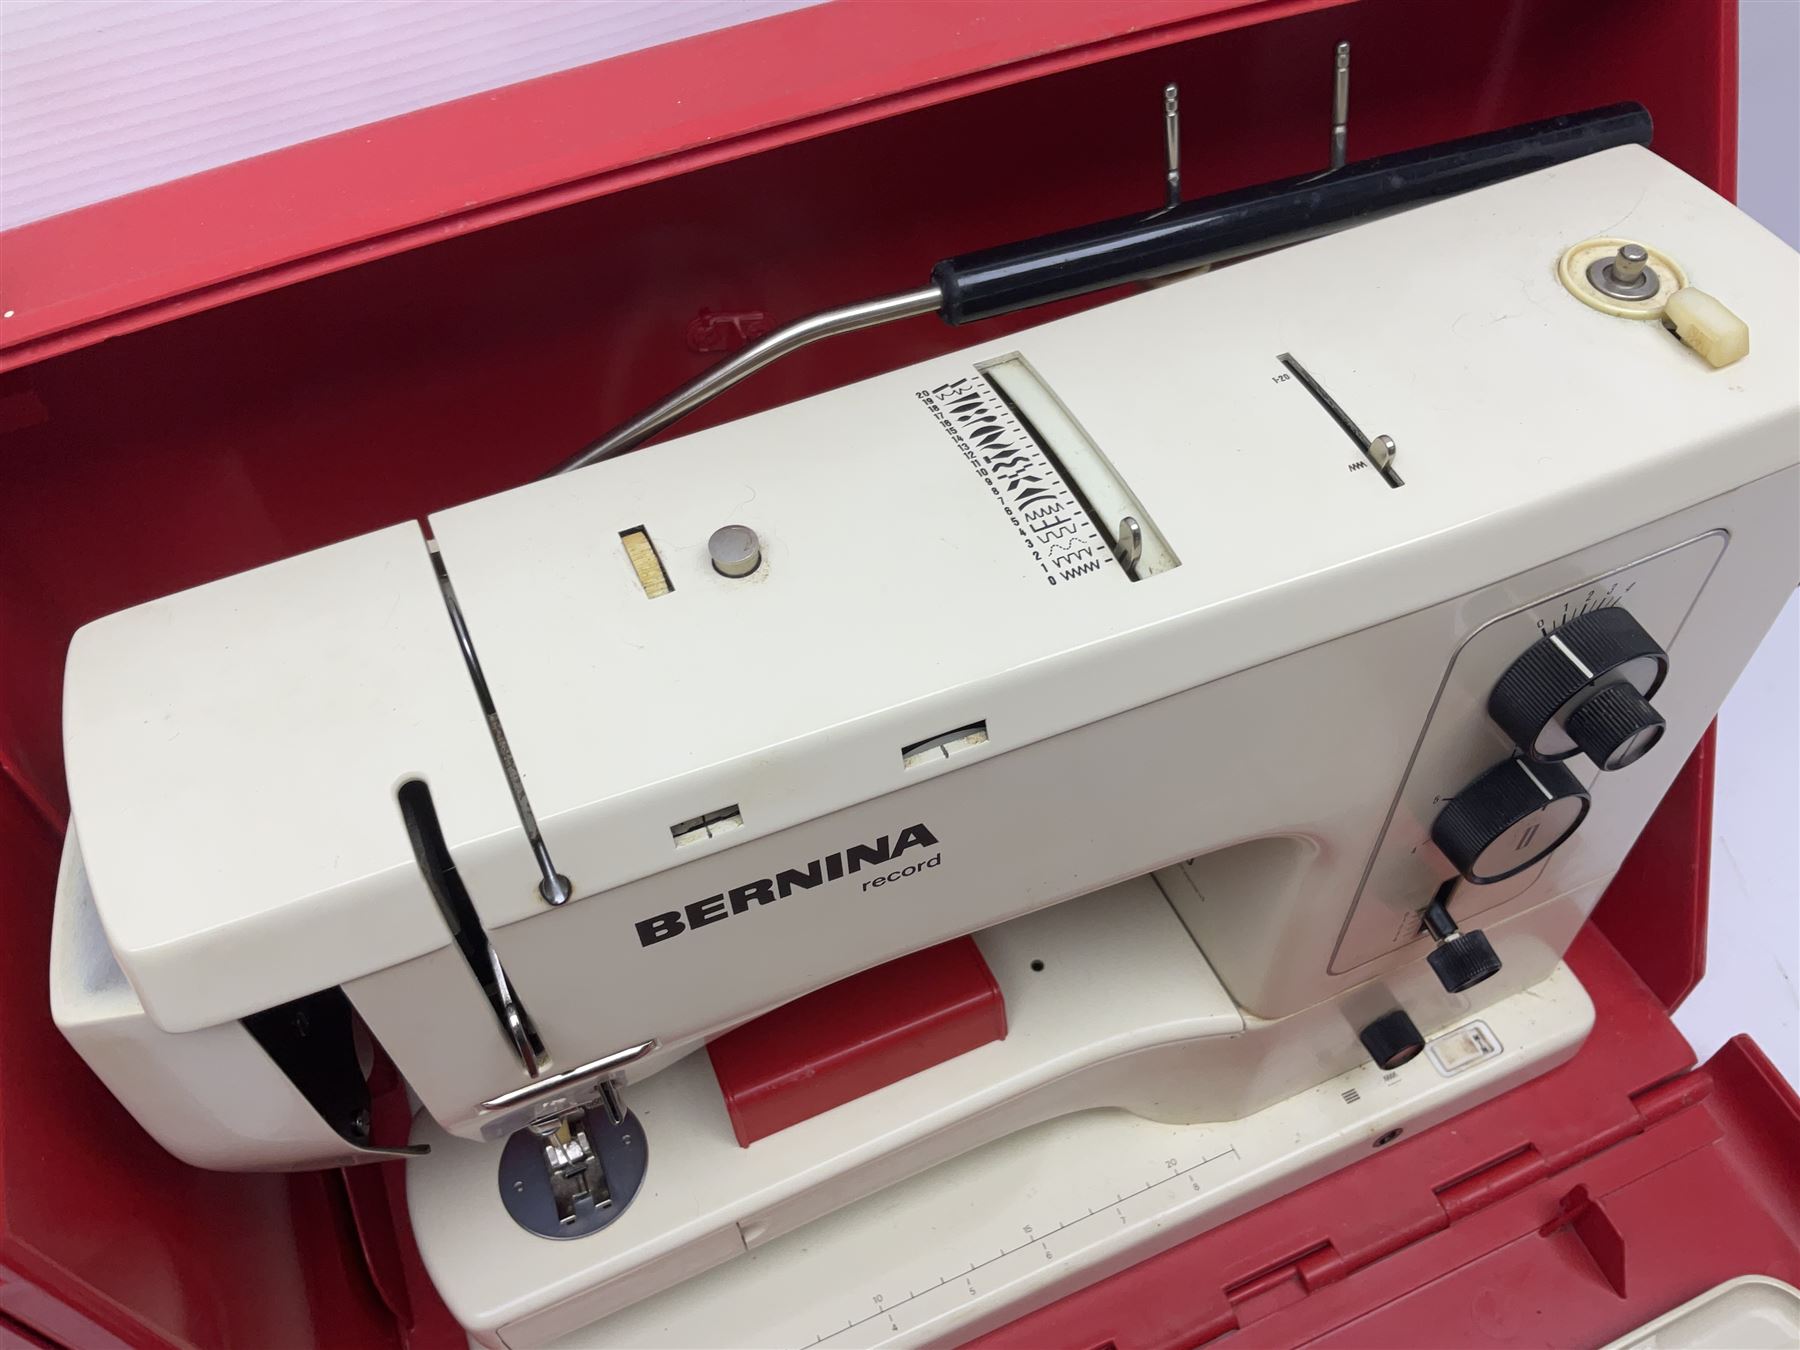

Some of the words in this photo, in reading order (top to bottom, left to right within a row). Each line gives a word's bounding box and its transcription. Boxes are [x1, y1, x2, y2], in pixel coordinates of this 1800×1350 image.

[1272, 373, 1291, 384] 1-20
[915, 390, 930, 399] 20
[922, 398, 934, 406] 19
[928, 404, 940, 412] 18
[934, 412, 944, 420] 17
[940, 420, 952, 428] 16
[946, 427, 958, 435] 15
[952, 436, 964, 444] 14
[958, 443, 970, 452] 13
[964, 451, 976, 460] 12
[971, 459, 981, 467] 11
[976, 468, 988, 477] 10
[985, 477, 993, 486] 9
[991, 487, 1000, 495] 8
[997, 497, 1005, 505] 7
[1004, 506, 1013, 515] 6
[1010, 517, 1019, 526] 5
[1019, 528, 1027, 536] 4
[1025, 539, 1034, 548] 3
[1032, 551, 1042, 560] 2
[1041, 563, 1048, 573] 1
[1048, 576, 1057, 586] 0
[1585, 590, 1595, 602] 2
[862, 852, 942, 892] record
[634, 823, 939, 947] BERNINA
[872, 1294, 883, 1303] 10
[1022, 1224, 1033, 1234] 15
[1164, 1158, 1178, 1169] 20
[969, 1287, 976, 1296] 5
[1046, 1251, 1053, 1259] 6
